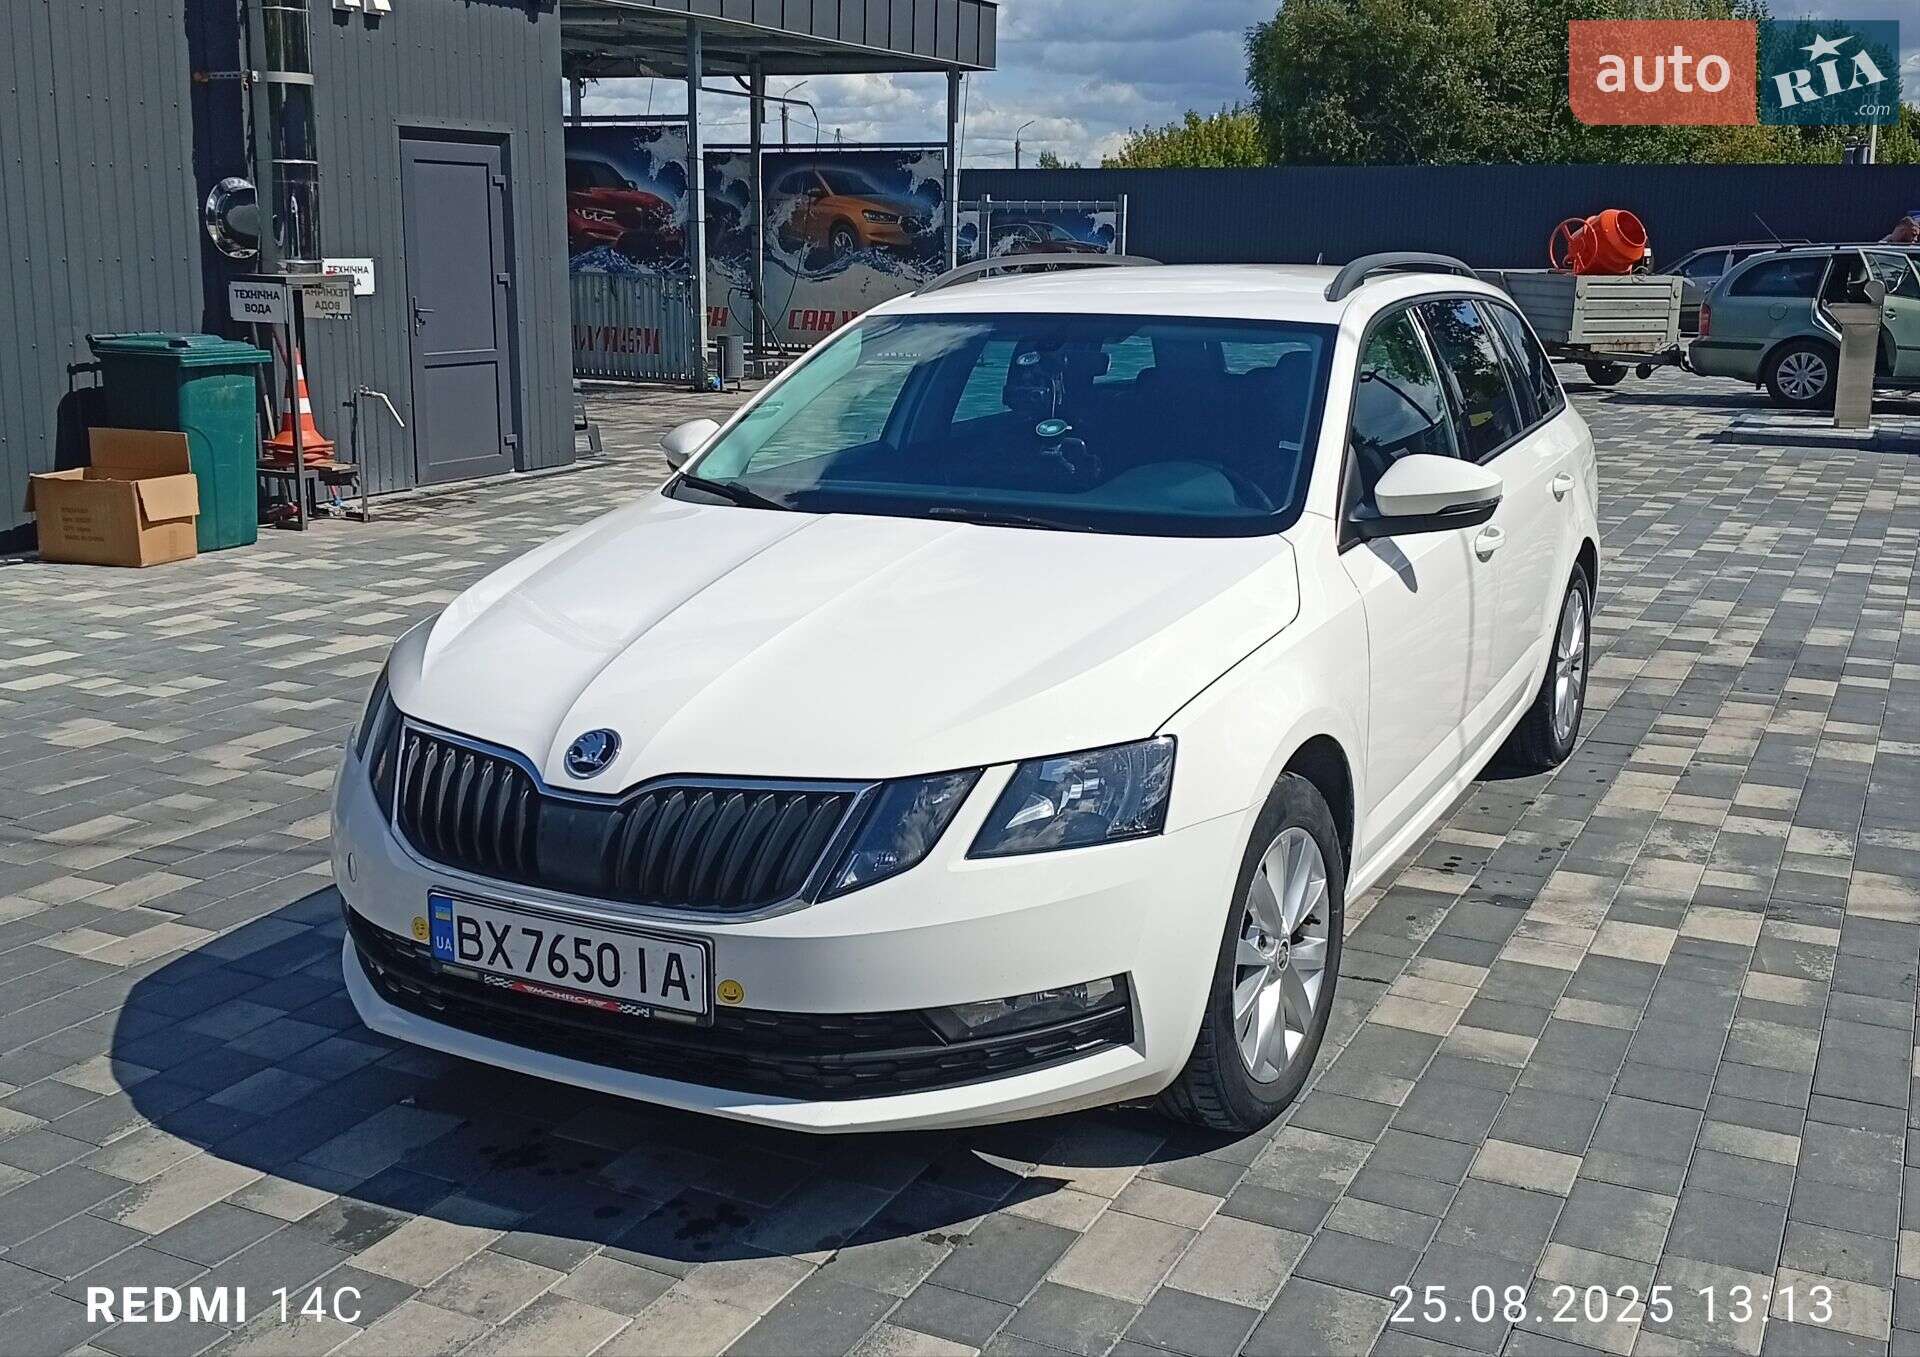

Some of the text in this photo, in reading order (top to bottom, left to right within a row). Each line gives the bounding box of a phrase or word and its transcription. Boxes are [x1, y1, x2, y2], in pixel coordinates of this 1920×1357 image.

[233, 288, 280, 300] ТЕХНІЧНА
[244, 303, 272, 314] ВОДА
[788, 309, 836, 331] CAR
[435, 936, 452, 952] UA
[457, 915, 514, 970] BX
[521, 927, 621, 988] 7650
